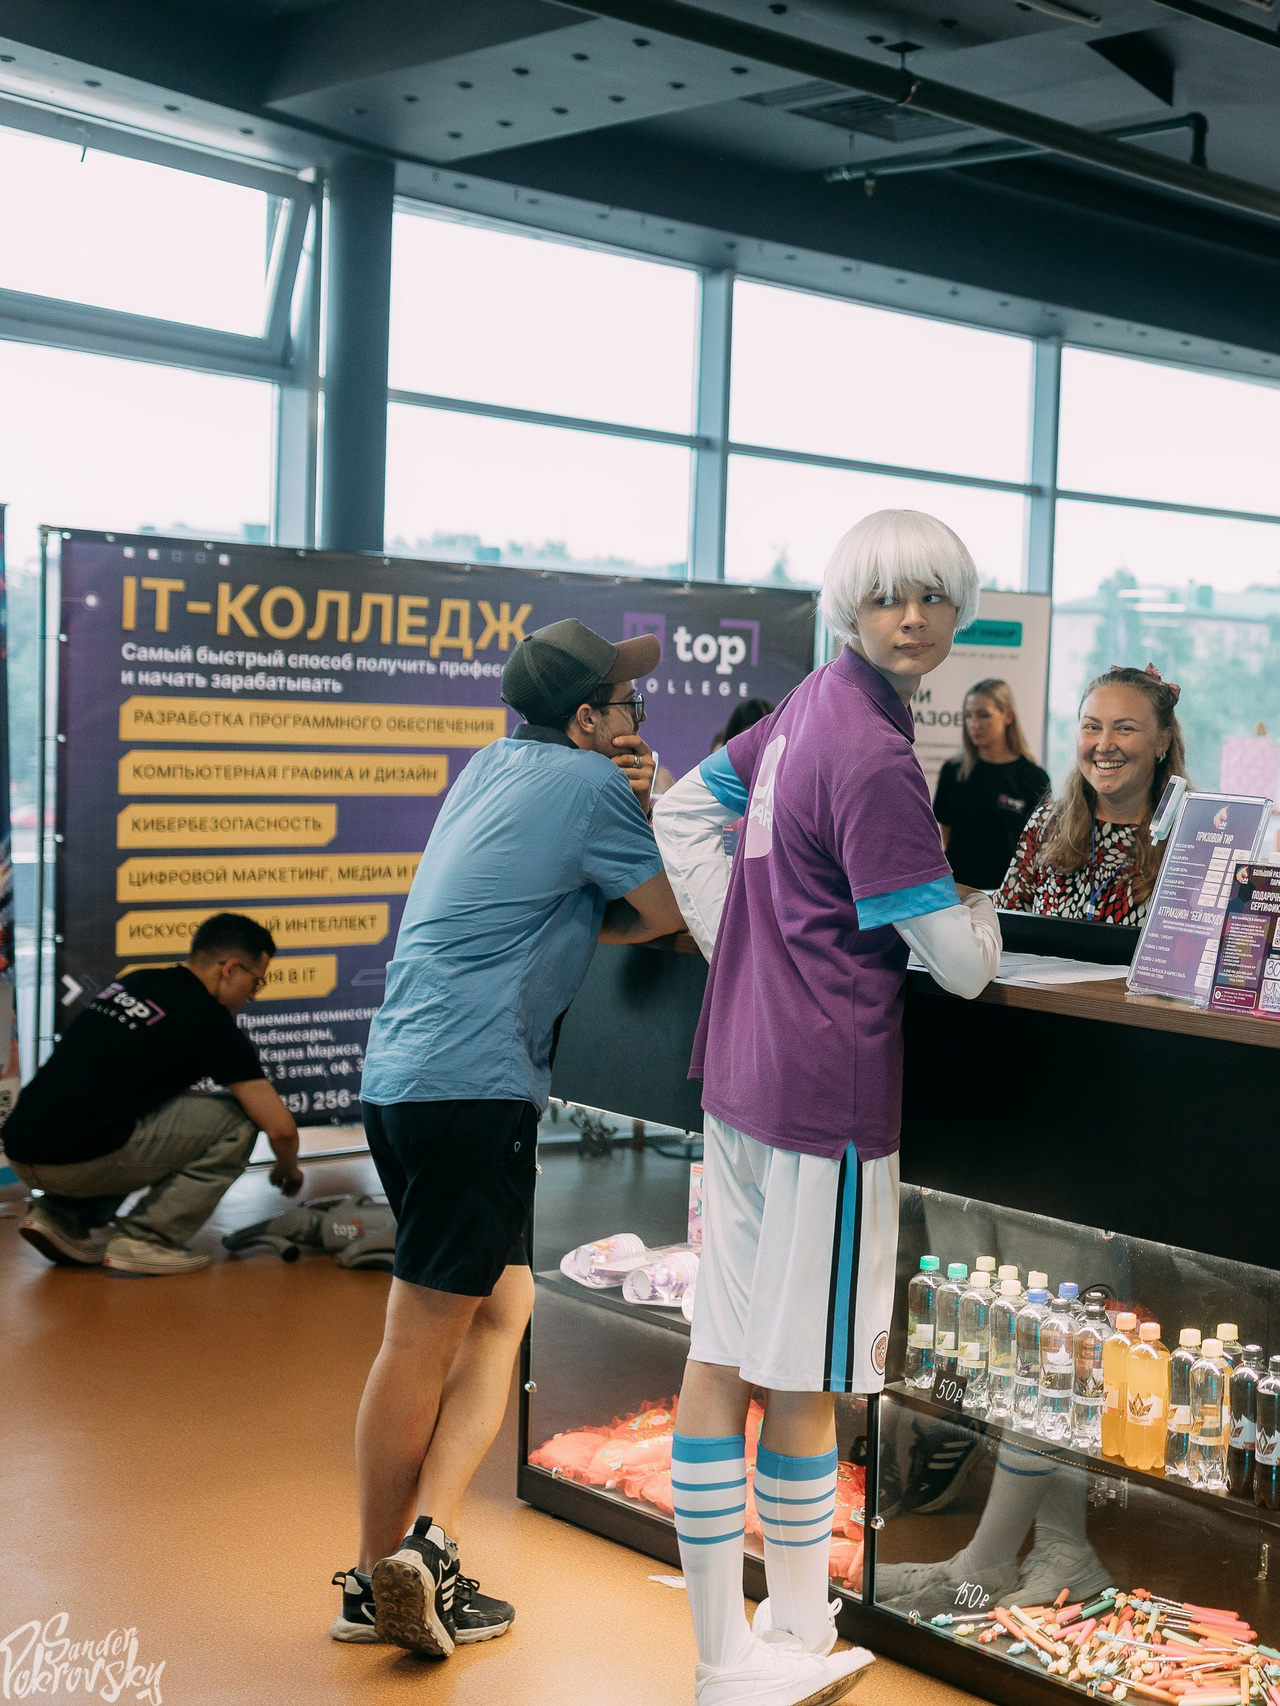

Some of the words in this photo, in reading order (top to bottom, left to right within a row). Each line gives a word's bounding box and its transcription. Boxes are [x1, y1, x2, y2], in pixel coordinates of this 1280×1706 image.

[122, 575, 533, 660] IT-КОЛЛЕДЖ
[121, 642, 193, 665] Самый
[196, 646, 284, 670] быстрый
[287, 652, 354, 671] способ
[356, 657, 438, 677] получить
[673, 626, 747, 675] top
[121, 670, 135, 686] и
[138, 670, 208, 689] начать
[210, 672, 344, 694] зарабатывать
[646, 677, 748, 697] OLLEGE
[133, 709, 244, 727] РАЗРАБОТКА
[249, 711, 381, 731] ПРОГРАММНОГО
[386, 715, 494, 734] ОБЕСПЕЧЕНИЯ
[132, 763, 277, 780] КОМПЬЮТЕРНАЯ
[281, 765, 354, 781] ГРАФИКА
[359, 767, 369, 781] И
[373, 765, 437, 784] ДИЗАЙН
[131, 815, 322, 833] КИБЕРБЕЗОПАСНОСТЬ
[128, 866, 227, 887] ЦИФРОВОЙ
[232, 866, 333, 883] МАРКЕТИНГ,
[338, 865, 392, 881] МЕДИА
[397, 865, 407, 878] И
[285, 914, 377, 932] ИНТЕЛЛЕКТ
[288, 968, 298, 983] В
[302, 967, 316, 982] IT
[113, 991, 151, 1018] top
[236, 1010, 310, 1032] Приемная
[258, 1046, 305, 1063] Карла
[288, 1062, 328, 1078] этаж,
